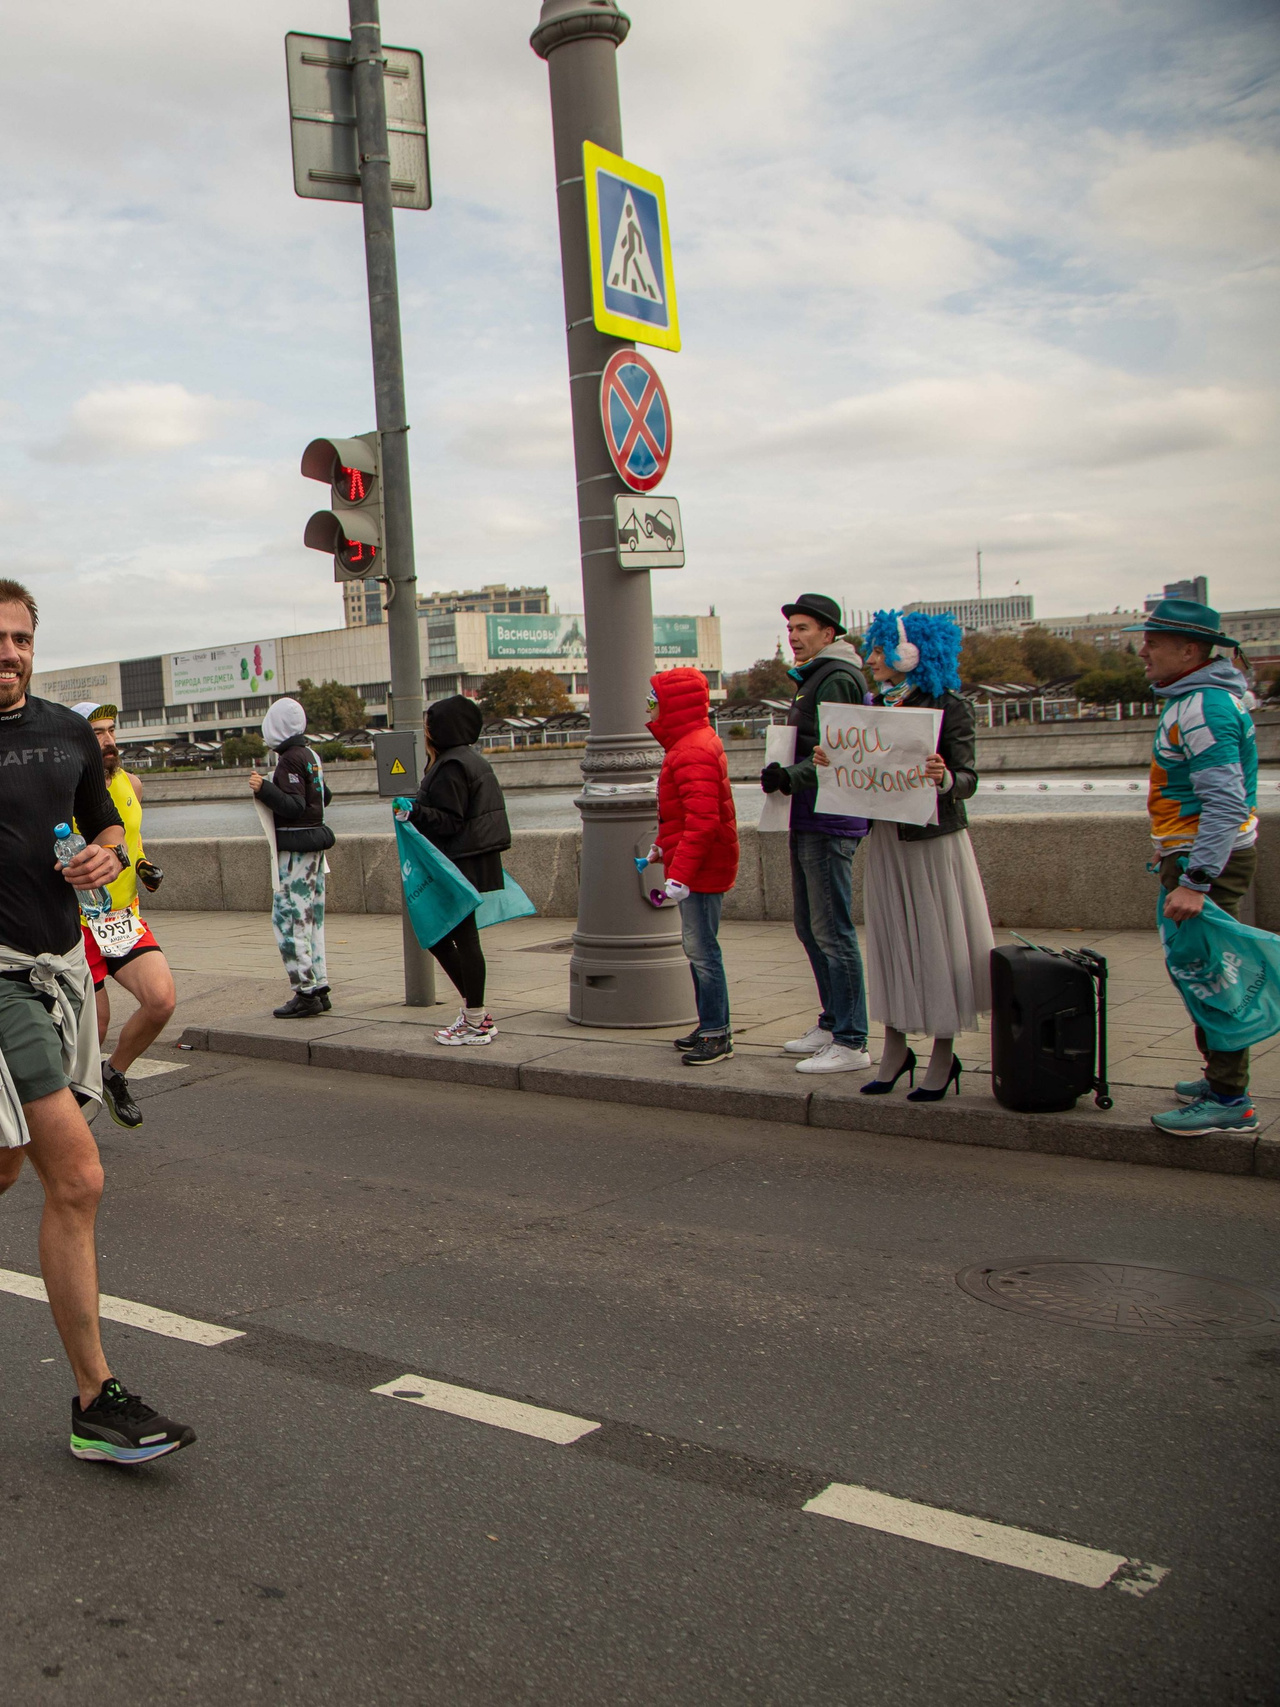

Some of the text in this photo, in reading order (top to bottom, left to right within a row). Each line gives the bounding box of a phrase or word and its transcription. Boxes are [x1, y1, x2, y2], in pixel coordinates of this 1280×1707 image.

[174, 673, 235, 688] ПРИРОДА ПРЕДМЕТА
[826, 725, 891, 764] иди
[407, 875, 435, 905] Пойма
[97, 919, 133, 939] 6957
